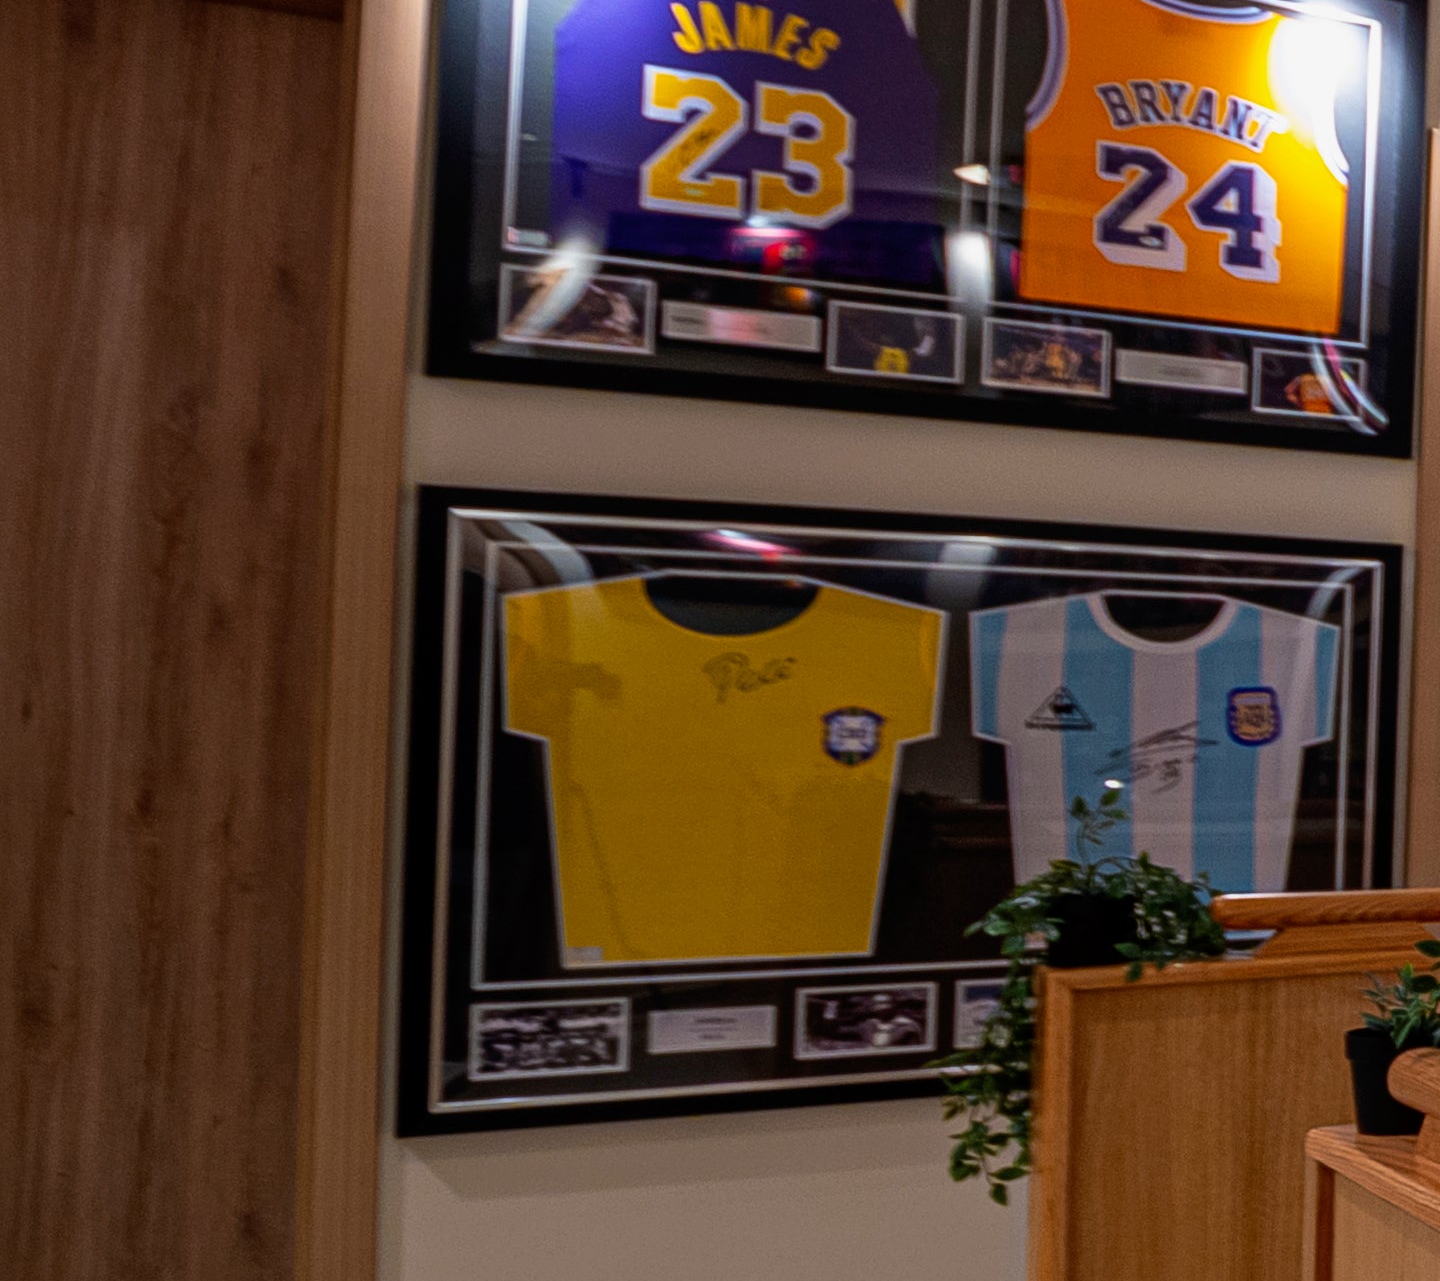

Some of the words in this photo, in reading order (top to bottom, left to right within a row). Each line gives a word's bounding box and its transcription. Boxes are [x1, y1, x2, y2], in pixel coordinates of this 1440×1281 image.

[670, 0, 841, 70] JAMES
[639, 63, 856, 231] 23
[1095, 79, 1290, 153] BRYANT
[1093, 139, 1282, 284] 24
